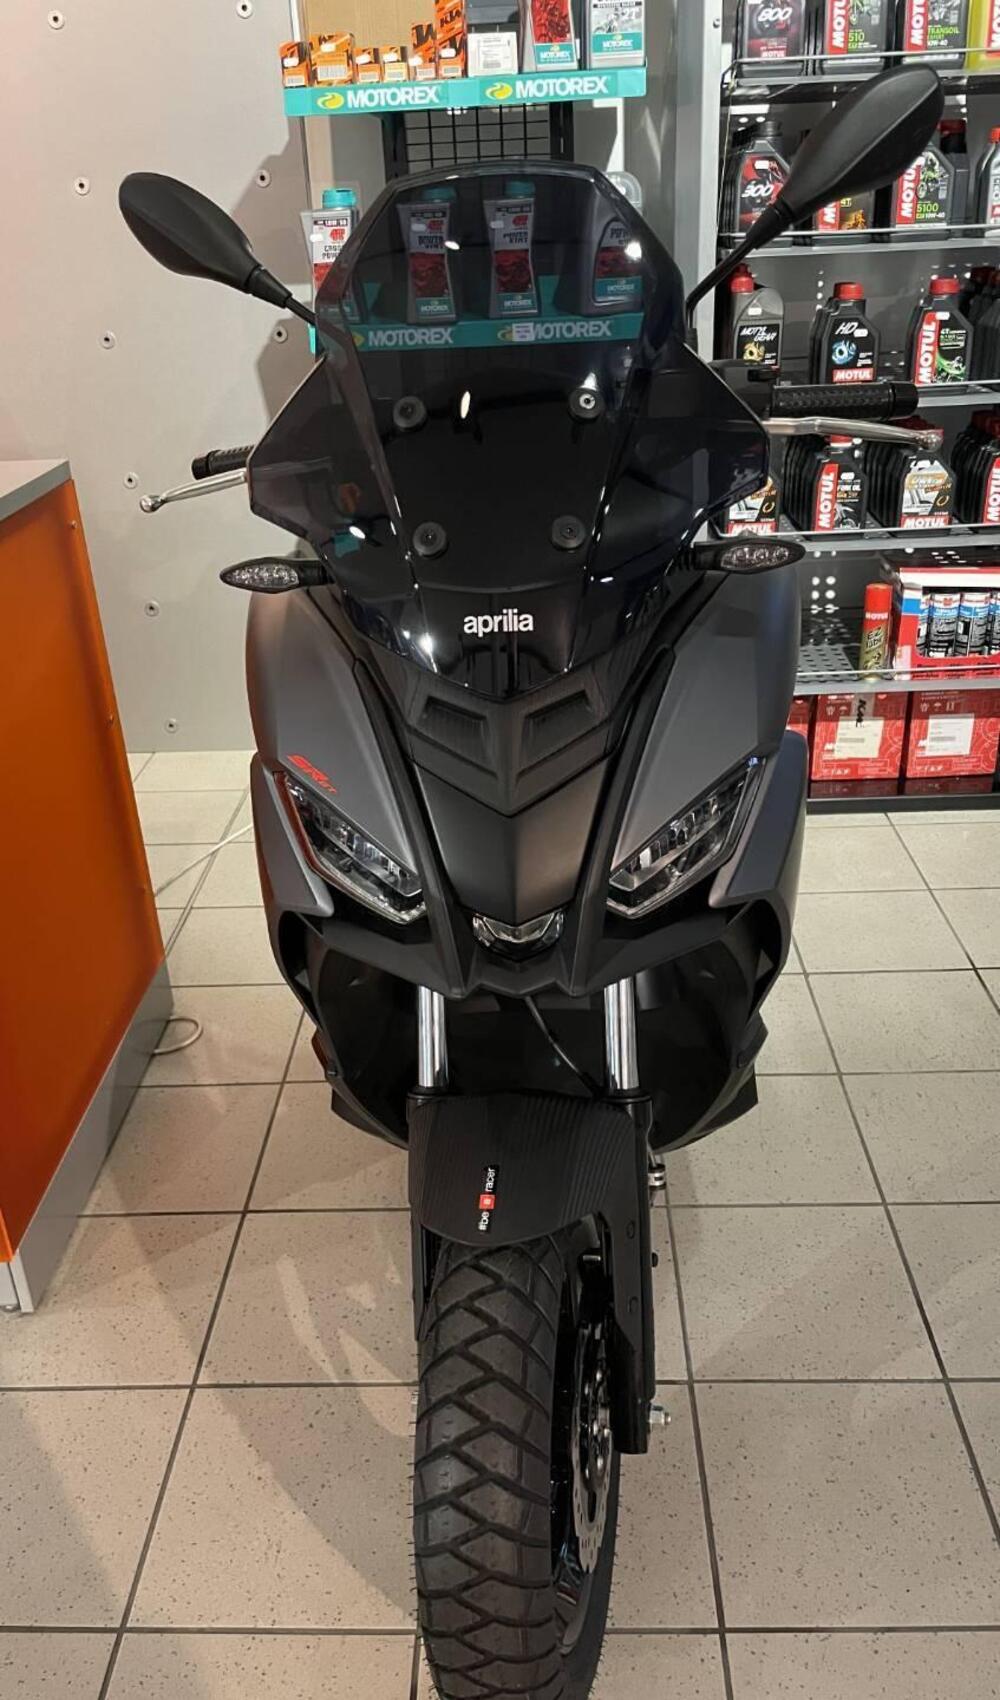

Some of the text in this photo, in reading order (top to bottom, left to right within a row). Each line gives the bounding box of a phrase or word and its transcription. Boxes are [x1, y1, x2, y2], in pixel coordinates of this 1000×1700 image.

[346, 86, 440, 109] MOTOREX
[515, 75, 609, 99] MOTOREX
[916, 203, 939, 213] 5100
[368, 327, 454, 347] MOTOREX
[835, 321, 859, 335] HD
[918, 321, 936, 384] MOTUL
[835, 369, 872, 381] MOTUL
[818, 473, 835, 528] MOTUL
[902, 515, 946, 528] MOTUL
[463, 608, 534, 638] aprilia
[485, 1167, 495, 1192] racer
